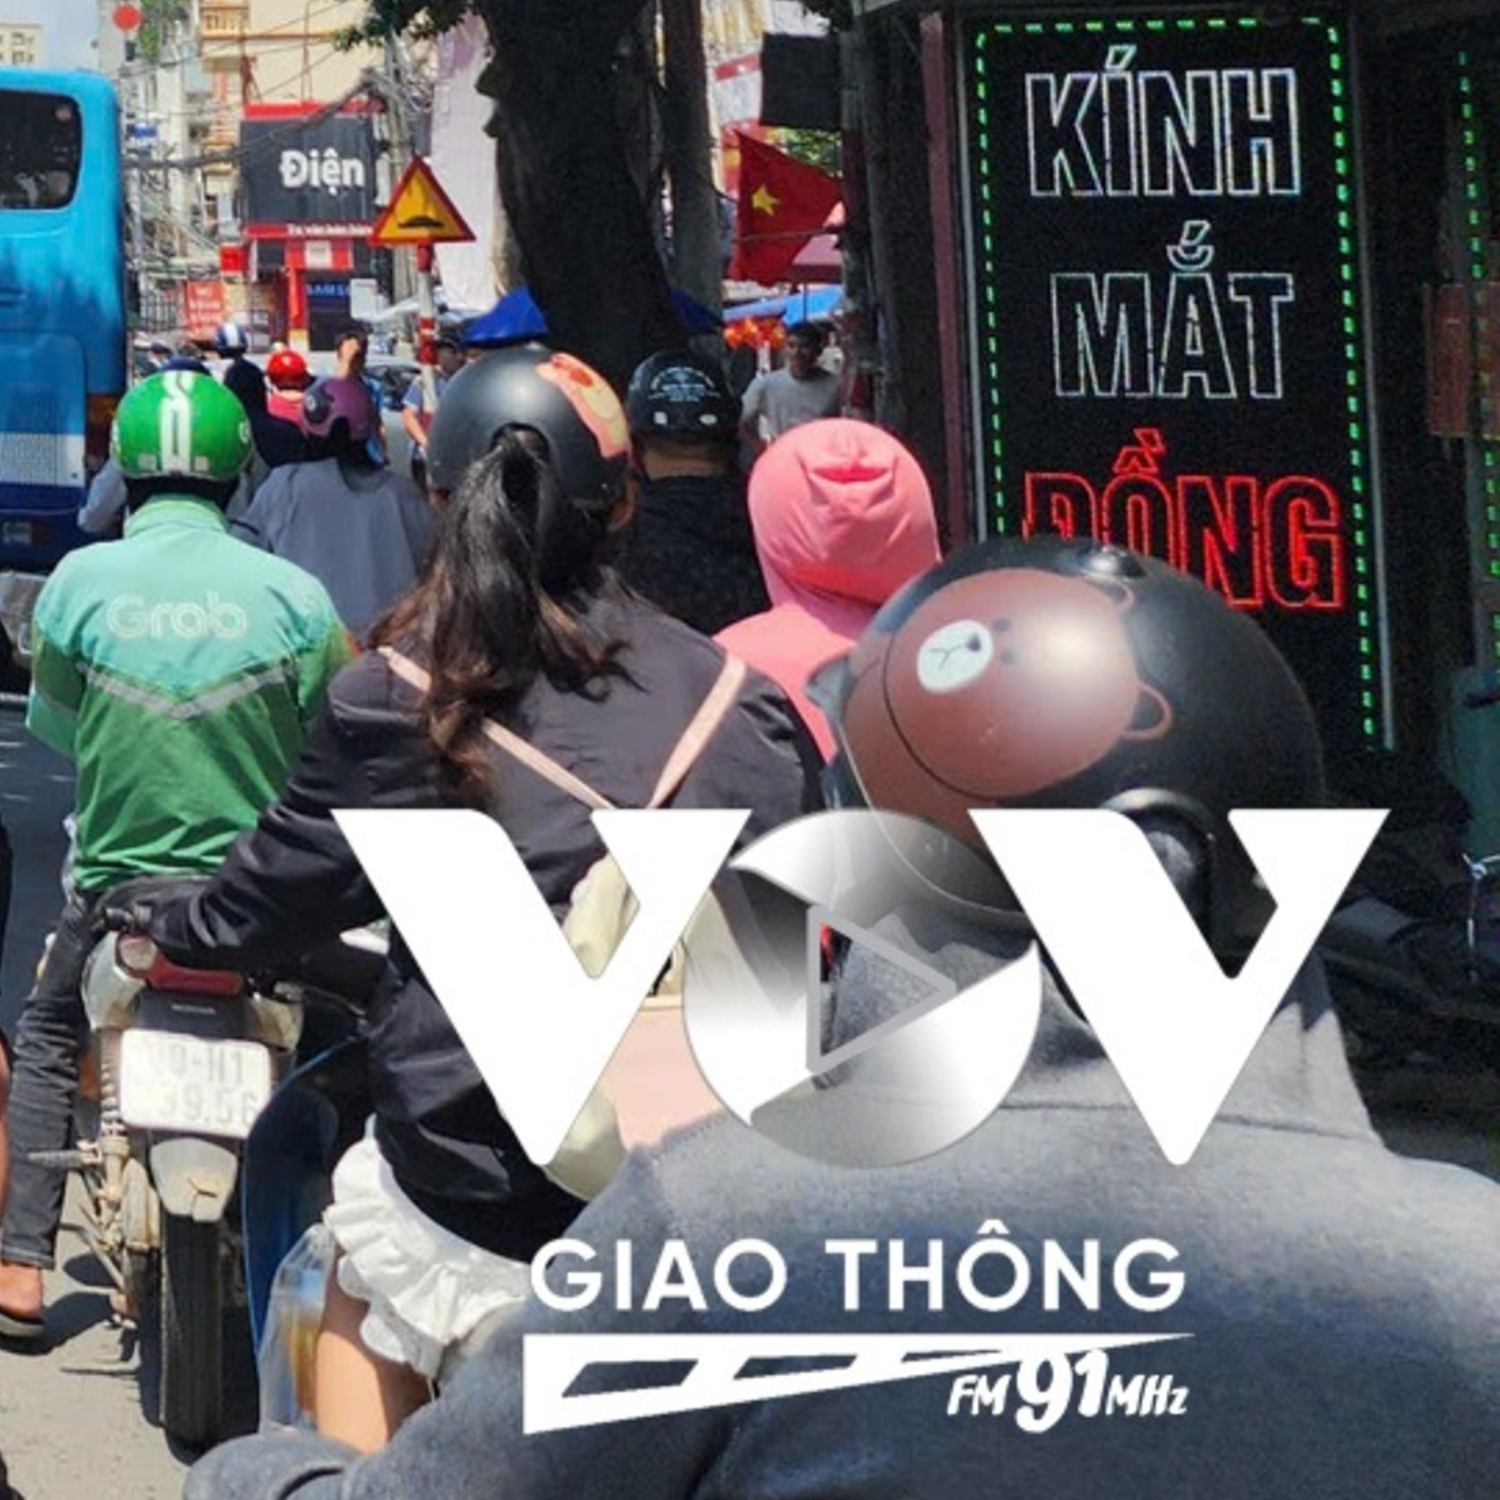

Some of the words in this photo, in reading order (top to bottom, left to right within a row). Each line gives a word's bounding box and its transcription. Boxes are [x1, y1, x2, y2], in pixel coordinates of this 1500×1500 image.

[1024, 44, 1301, 197] KÍNH
[279, 147, 366, 197] Điện
[1049, 219, 1296, 401] MẮT
[105, 590, 248, 640] Grab
